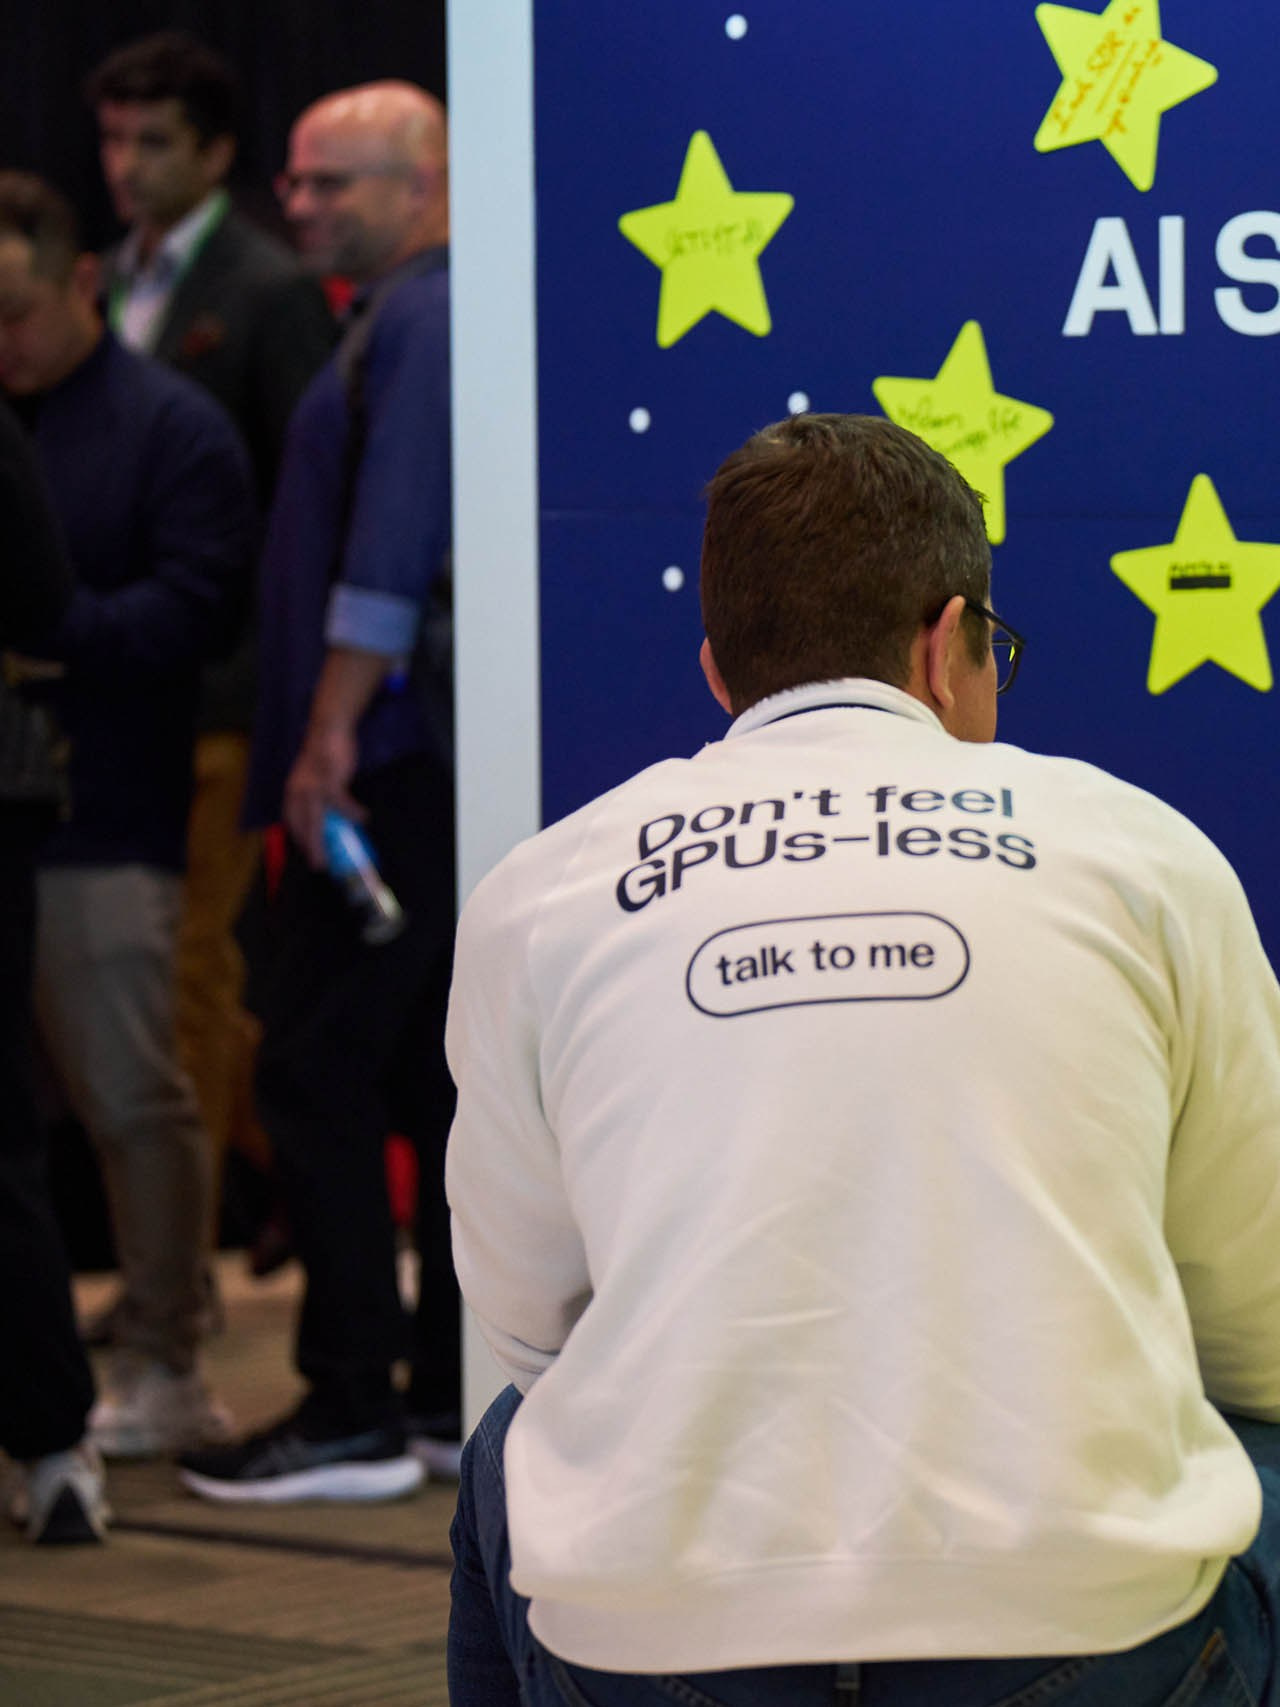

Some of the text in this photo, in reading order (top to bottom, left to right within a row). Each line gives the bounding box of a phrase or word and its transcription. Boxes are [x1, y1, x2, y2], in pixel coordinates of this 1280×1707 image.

[1062, 215, 1185, 336] AI
[638, 785, 1015, 861] Don't feel
[615, 820, 1037, 912] GPUs-less
[715, 941, 936, 986] talk to me
